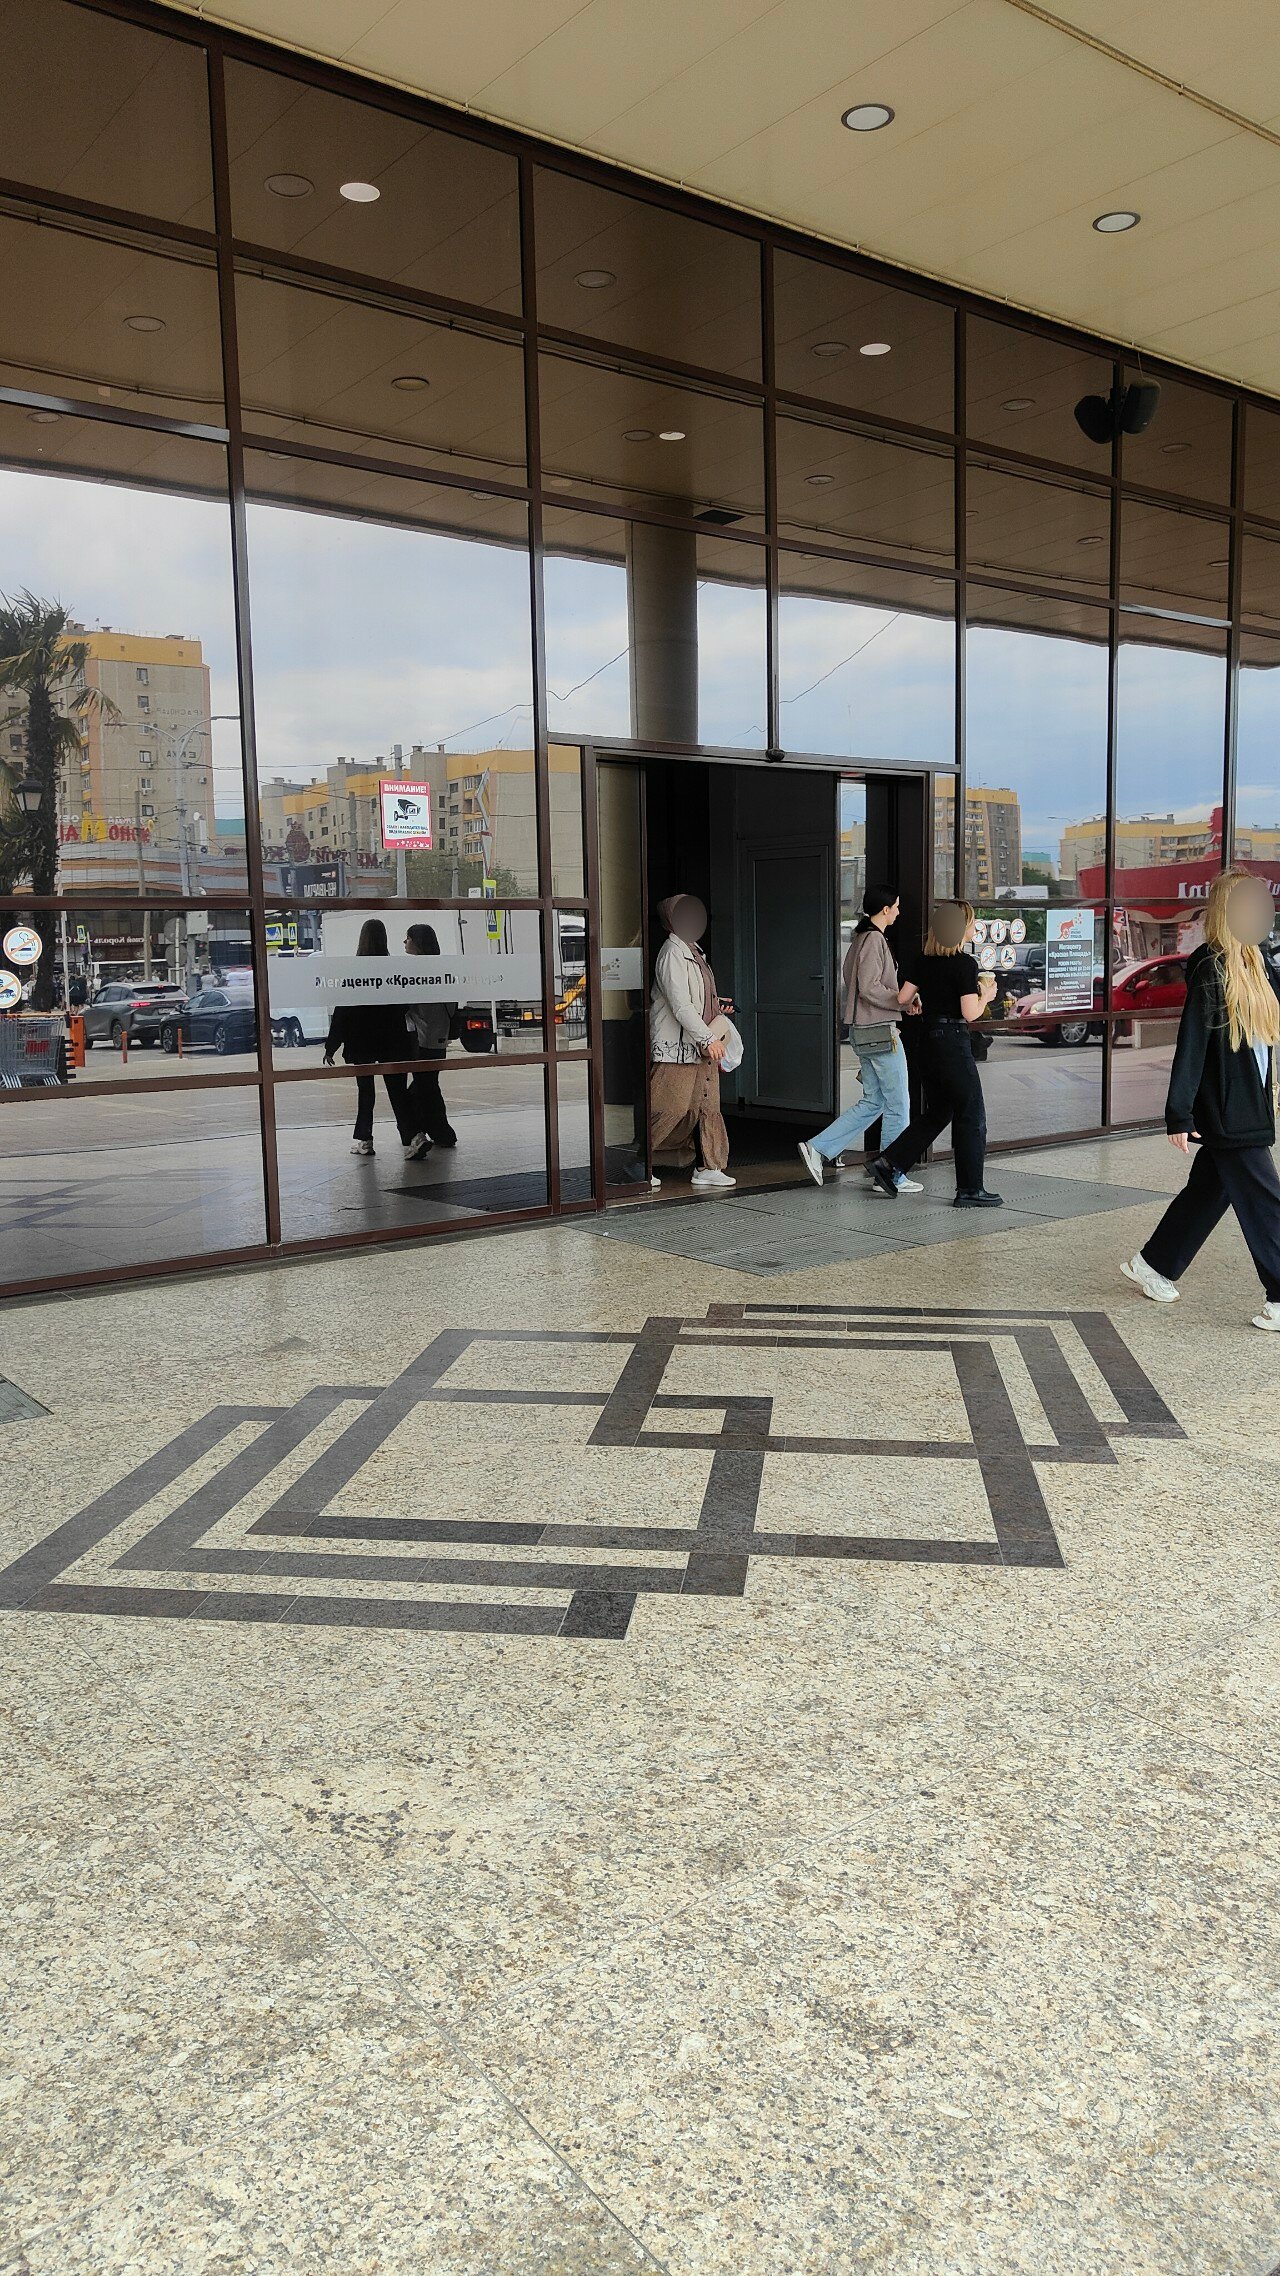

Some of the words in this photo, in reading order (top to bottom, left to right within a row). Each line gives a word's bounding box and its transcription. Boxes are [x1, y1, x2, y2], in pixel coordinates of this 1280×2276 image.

[384, 784, 427, 793] ВНИМАНИЕ!
[315, 975, 382, 990] Мегацентр
[385, 974, 441, 988] «Красная
